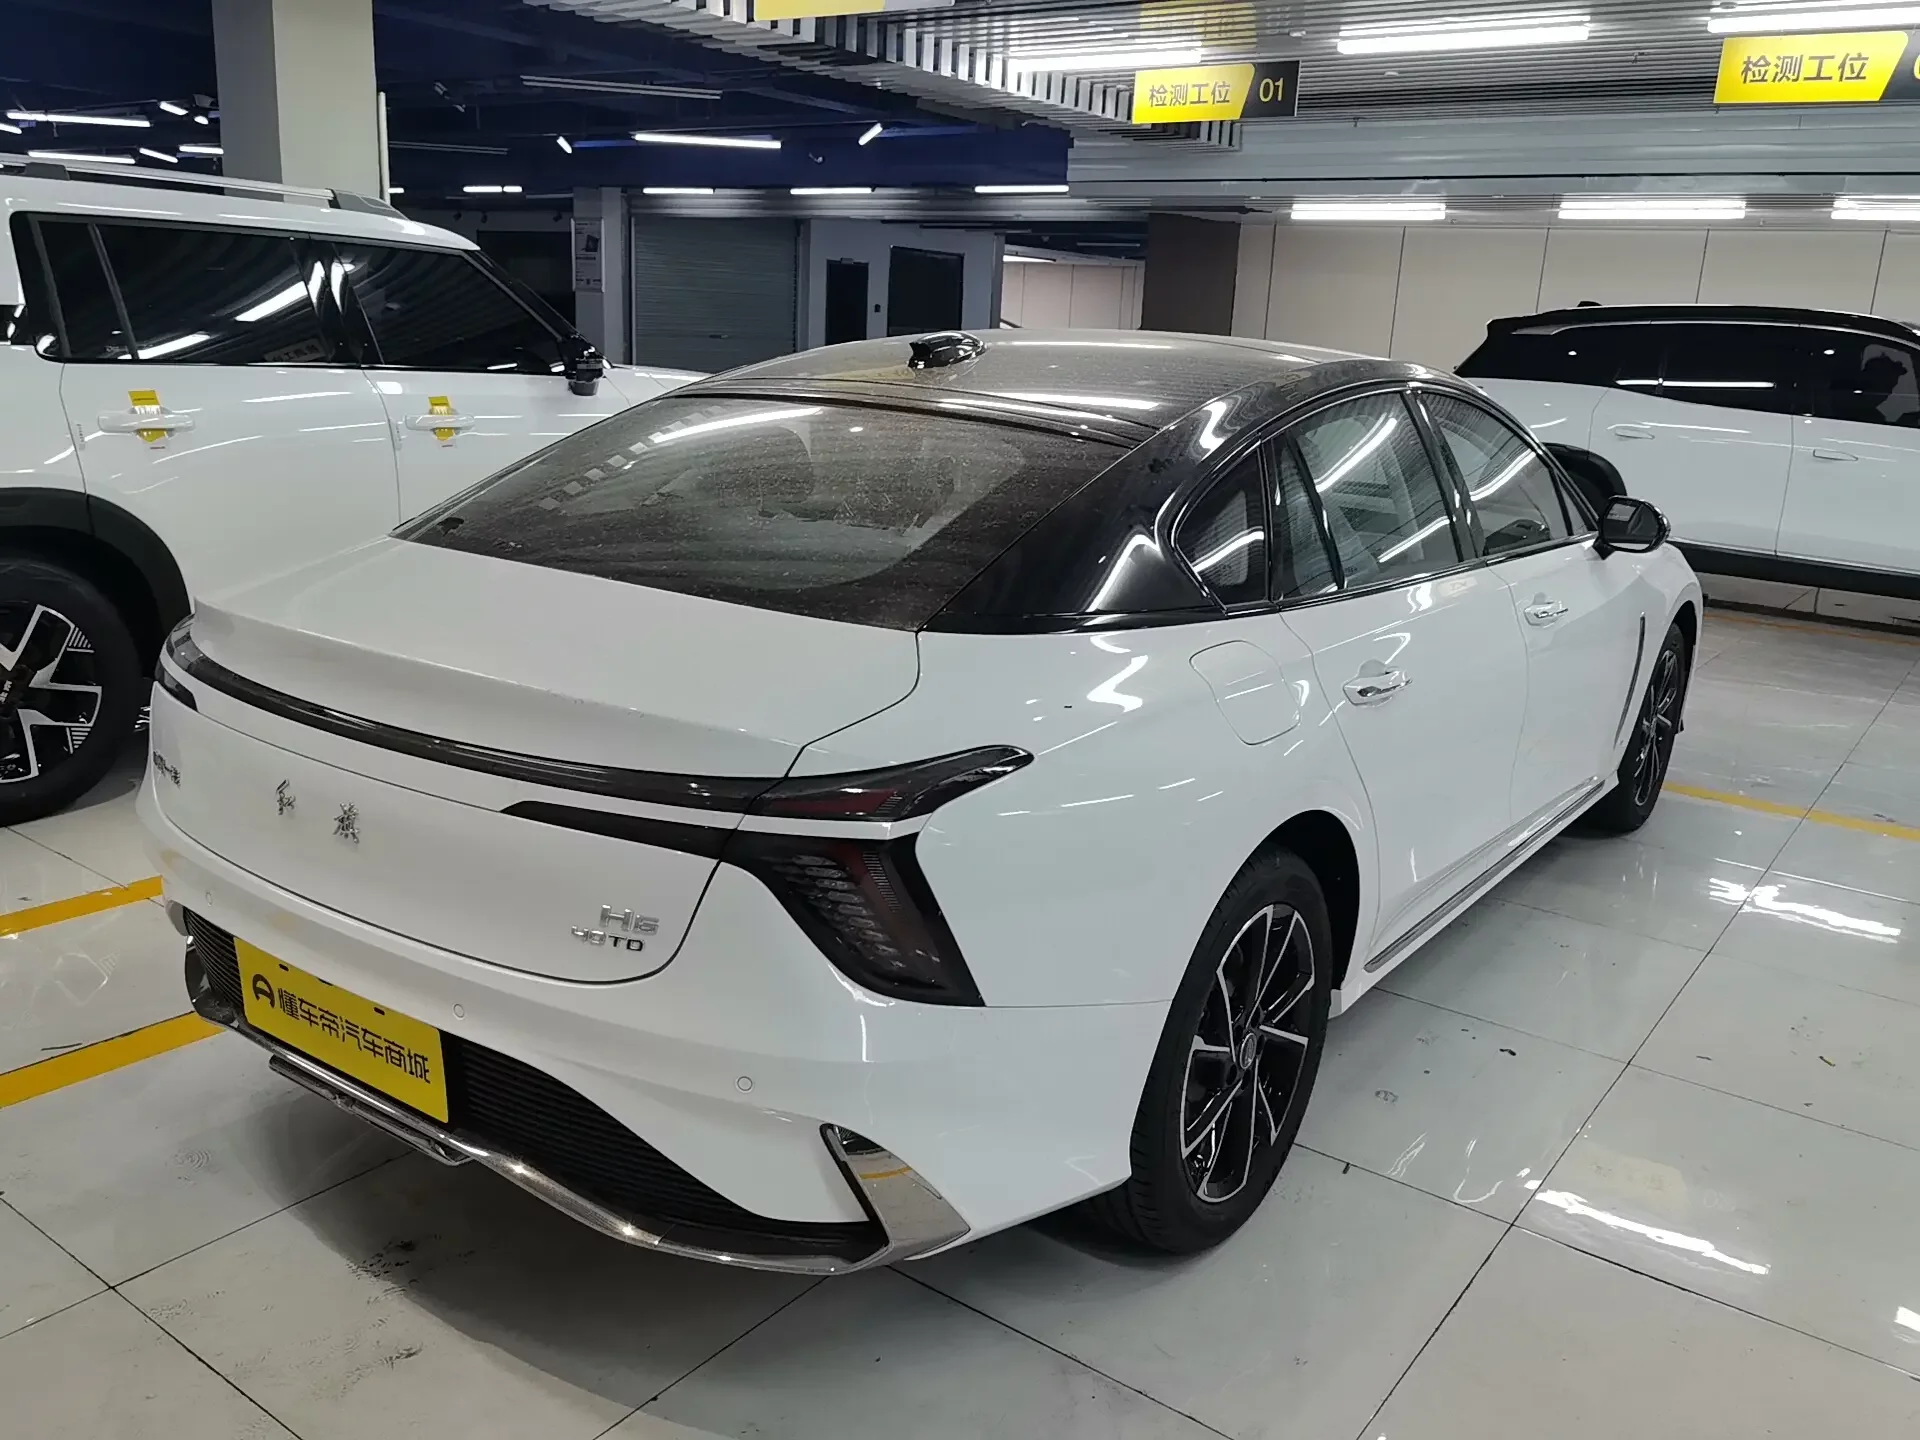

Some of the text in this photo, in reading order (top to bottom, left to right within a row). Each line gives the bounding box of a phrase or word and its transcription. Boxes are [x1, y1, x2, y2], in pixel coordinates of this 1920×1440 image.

[1741, 52, 1870, 84] 检测工位
[1149, 77, 1285, 108] 检测工位 01
[600, 904, 659, 936] H6
[277, 987, 431, 1084] 懂车帝汽车商城
